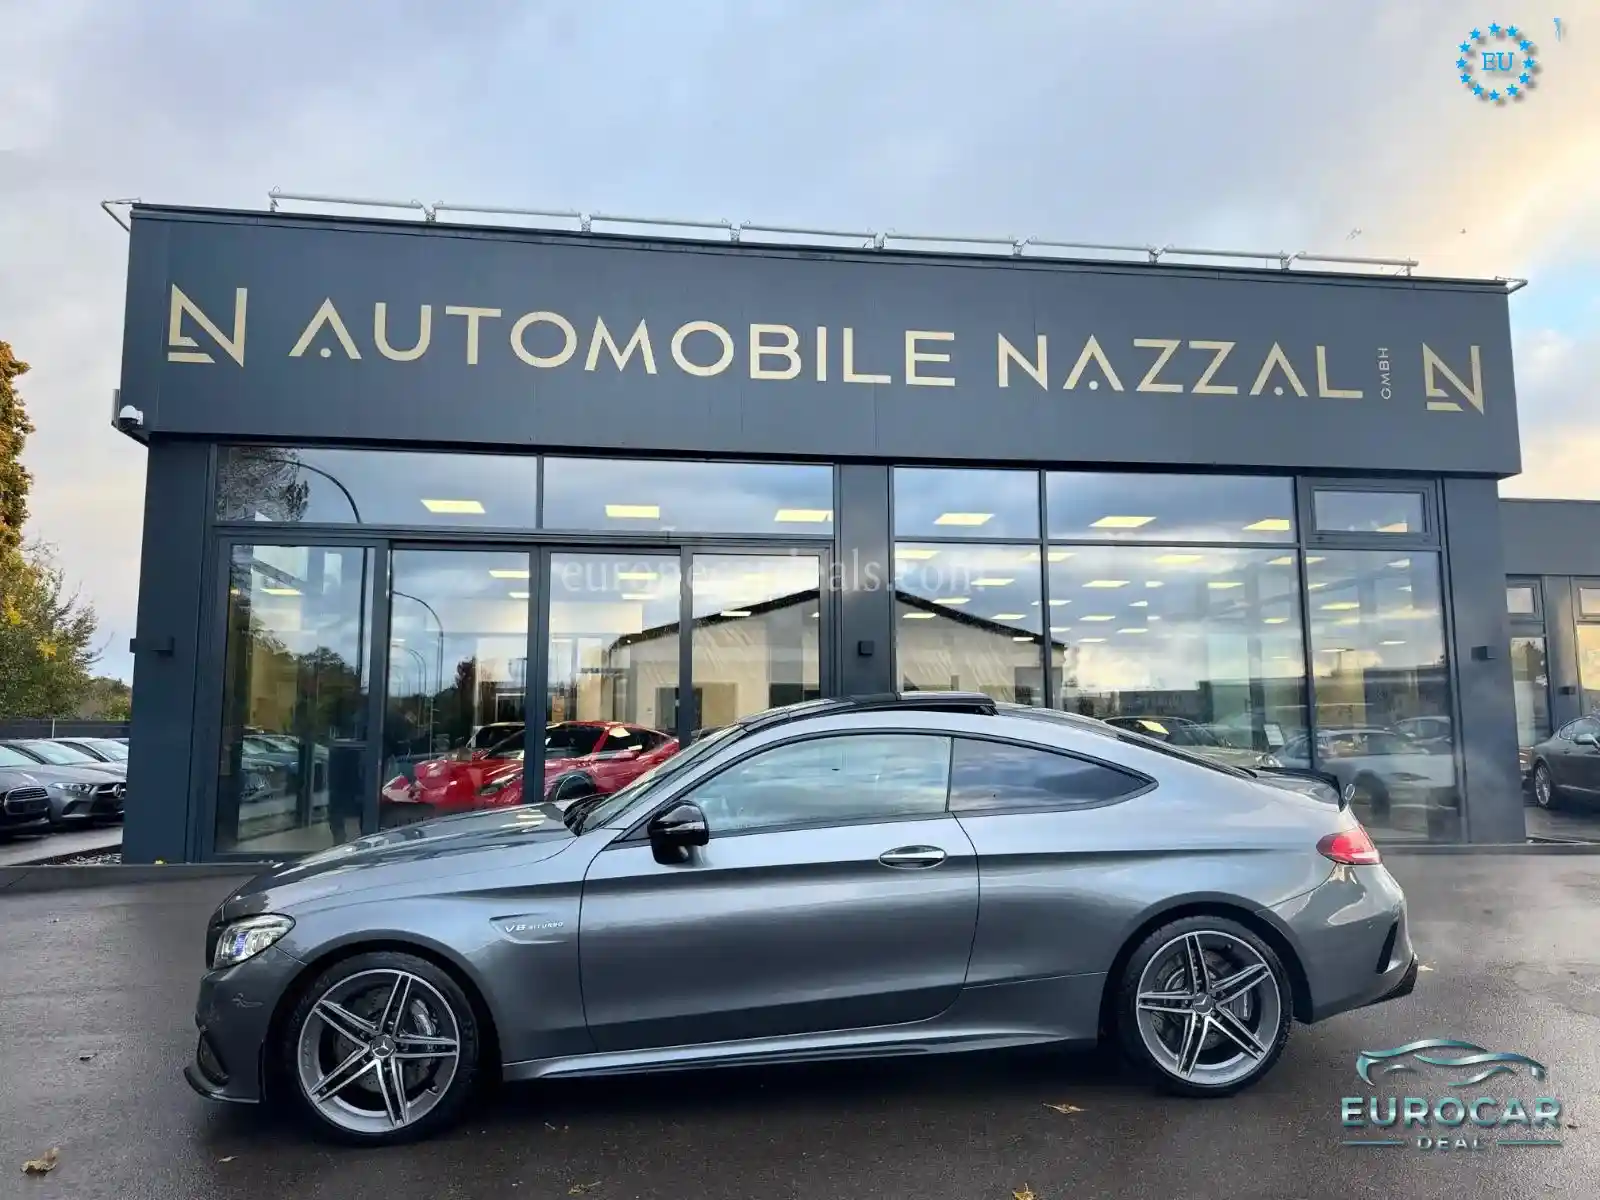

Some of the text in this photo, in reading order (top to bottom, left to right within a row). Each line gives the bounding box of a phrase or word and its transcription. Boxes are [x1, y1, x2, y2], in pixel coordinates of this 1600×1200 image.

[289, 297, 1363, 399] AUTOMOBILE NAZZAL
[1377, 347, 1392, 400] GMBH
[504, 923, 526, 933] V8
